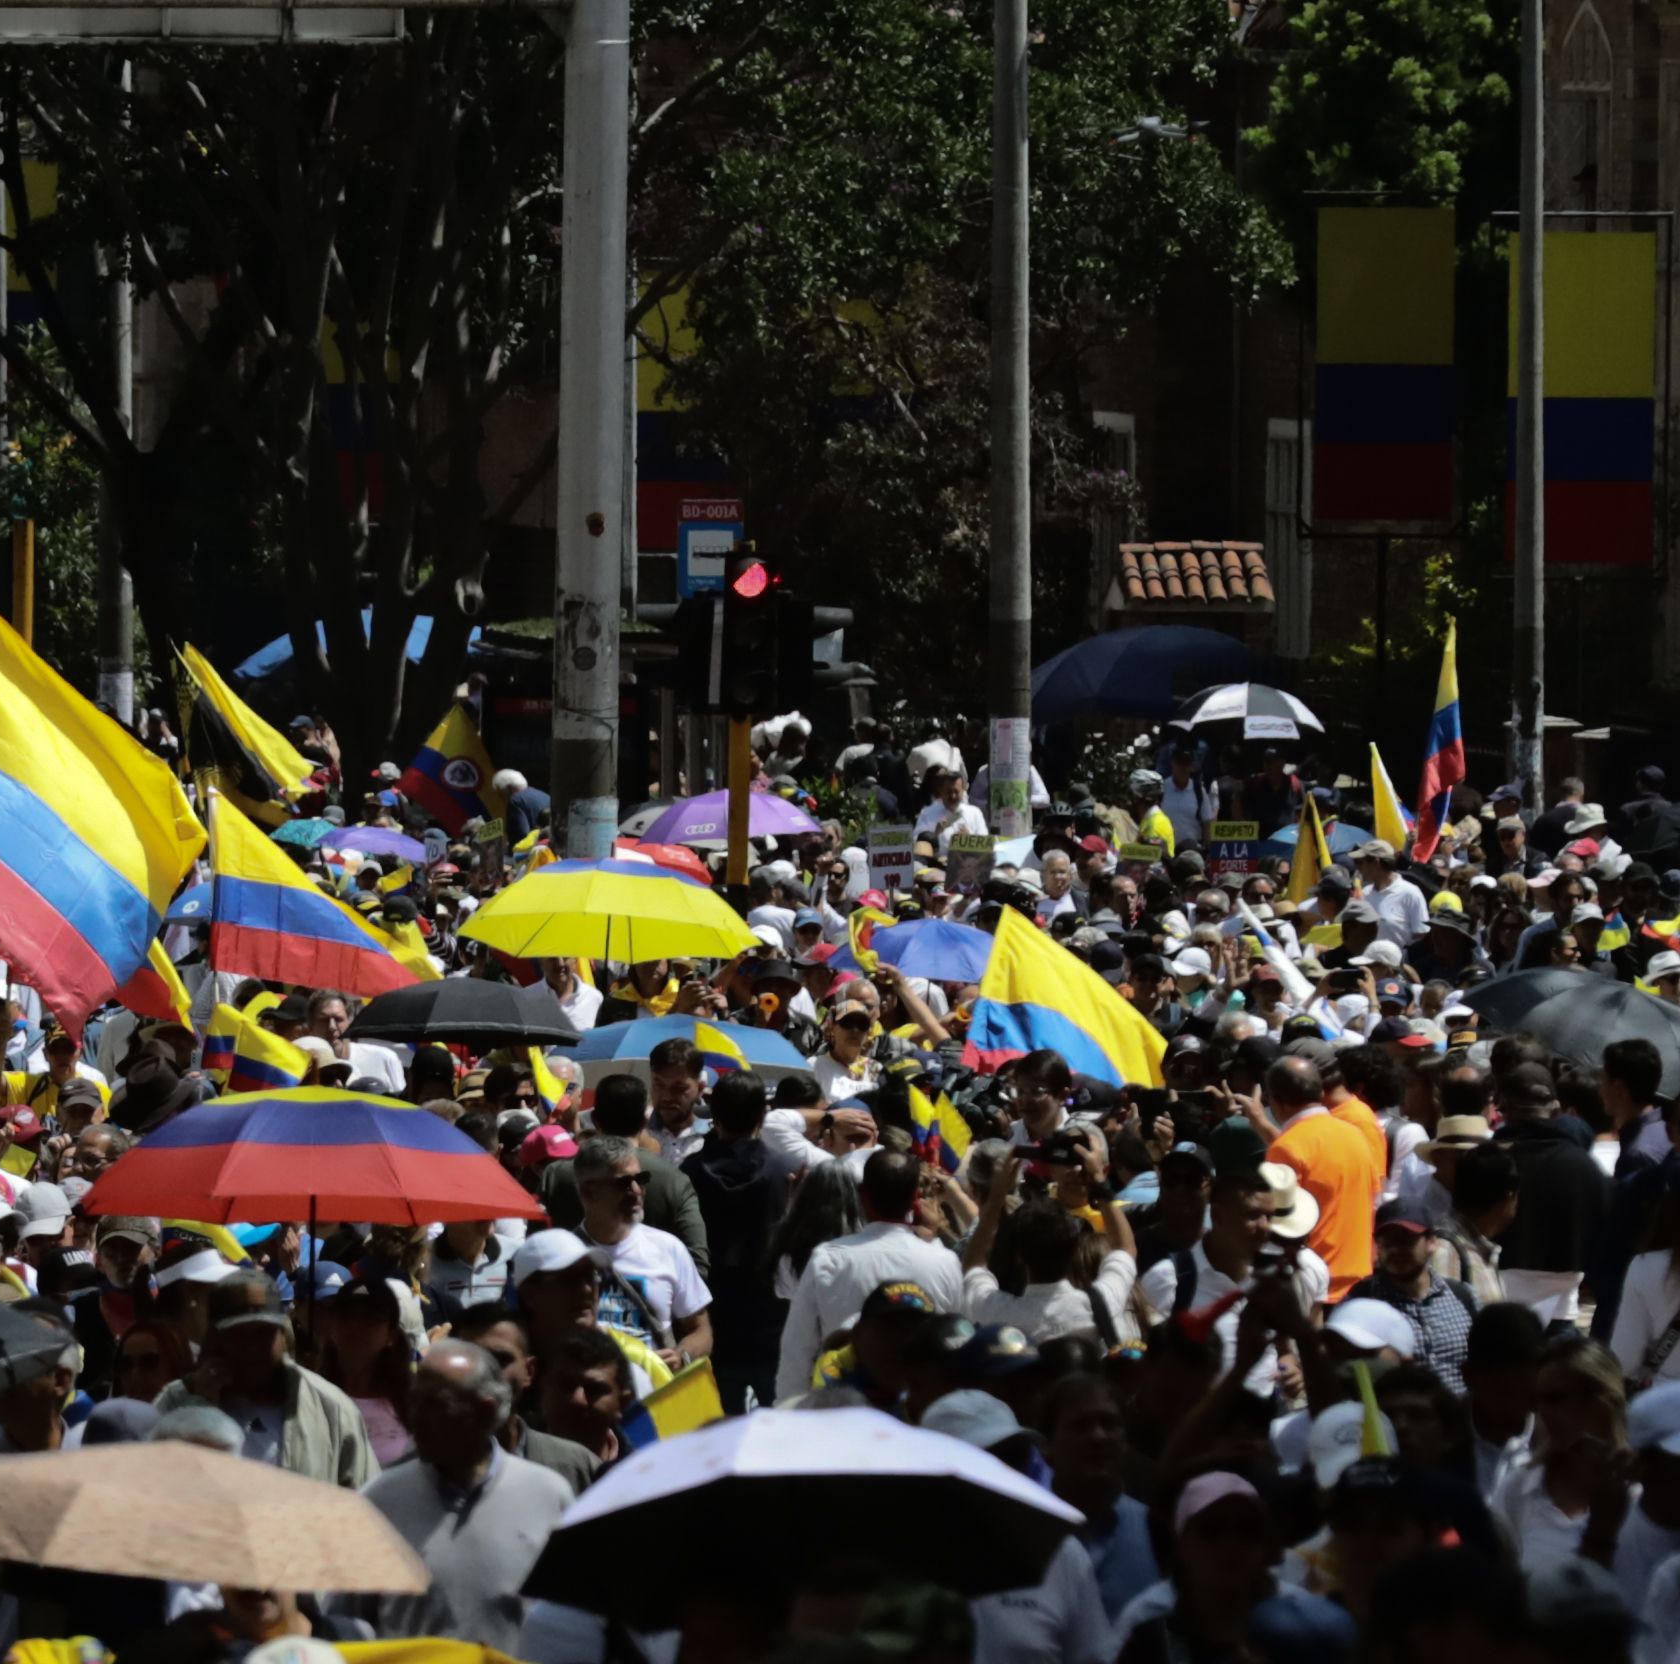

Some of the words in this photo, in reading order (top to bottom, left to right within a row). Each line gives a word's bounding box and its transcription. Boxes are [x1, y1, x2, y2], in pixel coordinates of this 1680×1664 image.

[682, 504, 738, 518] BD-001A
[951, 834, 994, 849] FUERA
[1233, 843, 1249, 858] LA
